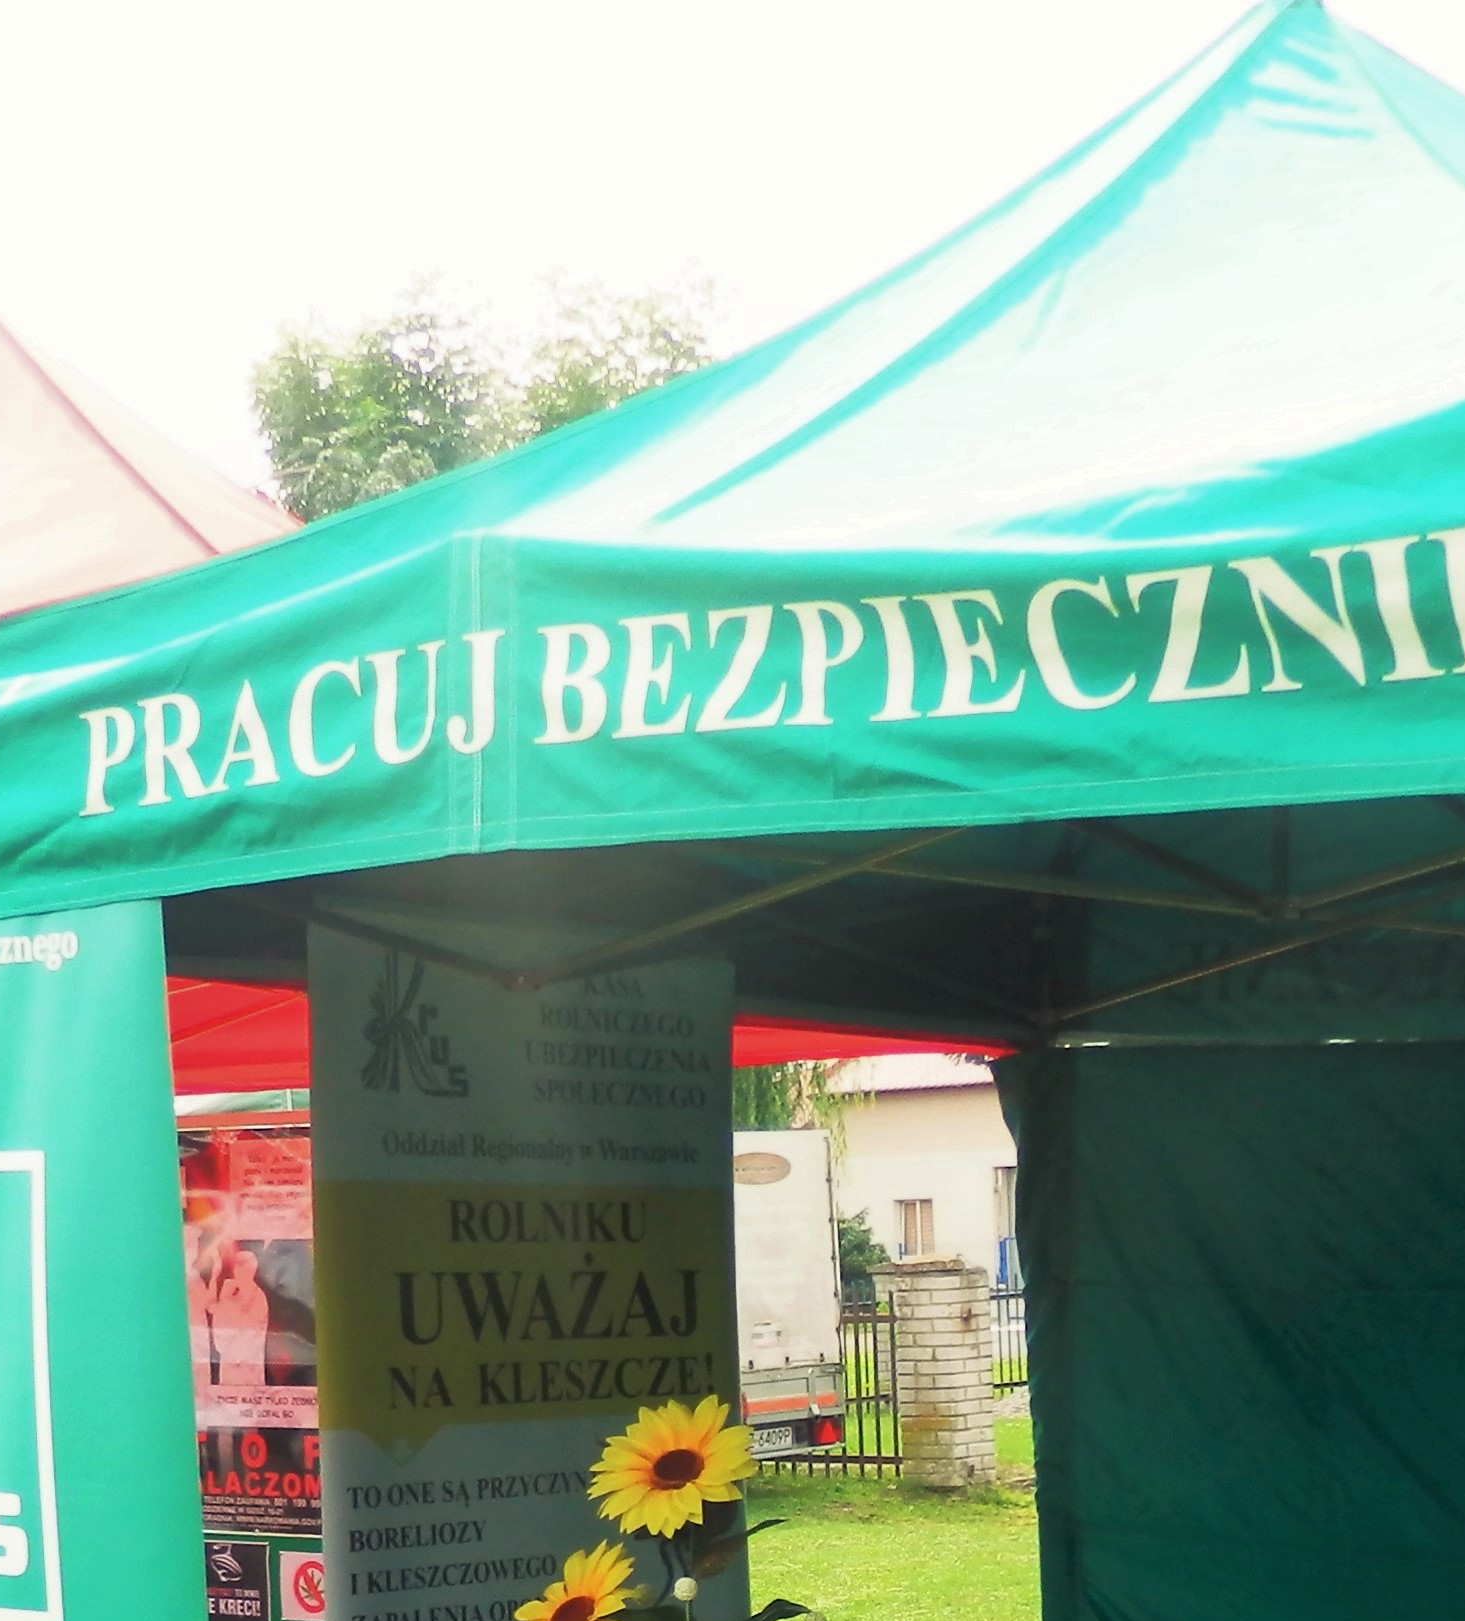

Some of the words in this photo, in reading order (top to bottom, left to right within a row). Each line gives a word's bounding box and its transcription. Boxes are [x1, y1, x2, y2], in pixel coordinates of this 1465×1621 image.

[79, 628, 507, 818] PRACUJ
[539, 1004, 695, 1039] ROLNICZEGO
[524, 1039, 711, 1074] UBEZPIECZENIA
[382, 1130, 465, 1158] Oddział
[472, 1133, 575, 1167] Regionalny
[579, 1142, 594, 1160] w
[597, 1137, 700, 1166] Warszawie
[449, 1199, 648, 1244] ROLNIKU
[394, 1250, 702, 1347] UWAŻAJ
[388, 1365, 454, 1411] NA
[477, 1352, 715, 1406] KLESZCZE!
[347, 1485, 382, 1510] TO
[387, 1481, 436, 1507] ONE
[442, 1479, 471, 1508] SĄ
[348, 1519, 487, 1553] BORELIOZY
[350, 1572, 360, 1596] I
[367, 1553, 558, 1596] KLESZCZOWEGO
